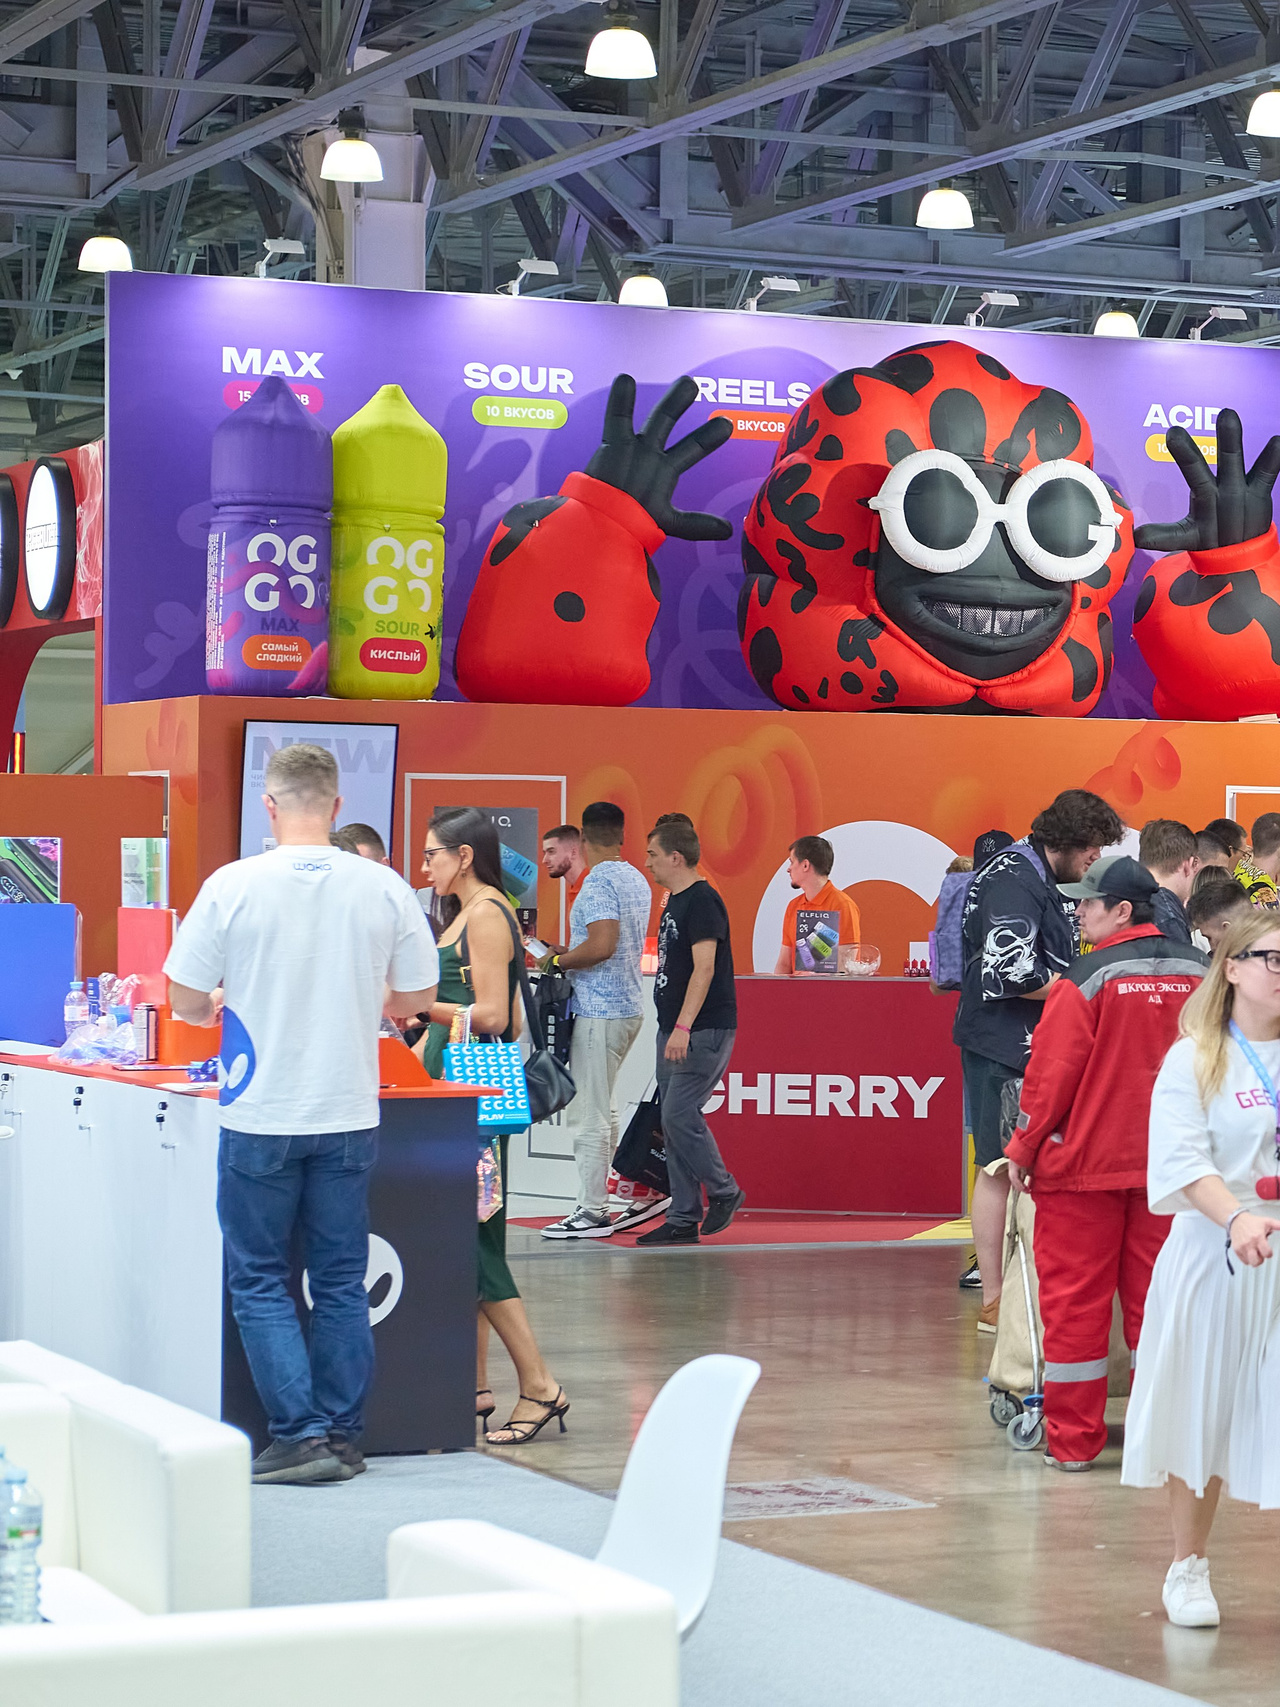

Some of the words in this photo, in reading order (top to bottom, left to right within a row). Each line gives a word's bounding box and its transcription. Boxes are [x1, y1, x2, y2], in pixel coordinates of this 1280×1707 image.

[222, 346, 325, 379] MAX
[463, 362, 574, 394] SOUR
[693, 376, 812, 408] REELS
[486, 405, 500, 417] 10
[504, 406, 555, 420] ВКУСОВ
[1143, 403, 1222, 430] ACID
[737, 420, 786, 432] ВКУСОВ
[247, 532, 317, 574] OG
[366, 536, 433, 577] OG
[261, 617, 299, 633] MAX
[375, 619, 420, 636] SOUR
[261, 641, 299, 652] самый
[256, 651, 302, 663] сладкий
[251, 736, 396, 773] NW
[1157, 982, 1191, 993] ЭКСПО
[1148, 995, 1162, 1004] АД
[1235, 1088, 1276, 1109] GEE
